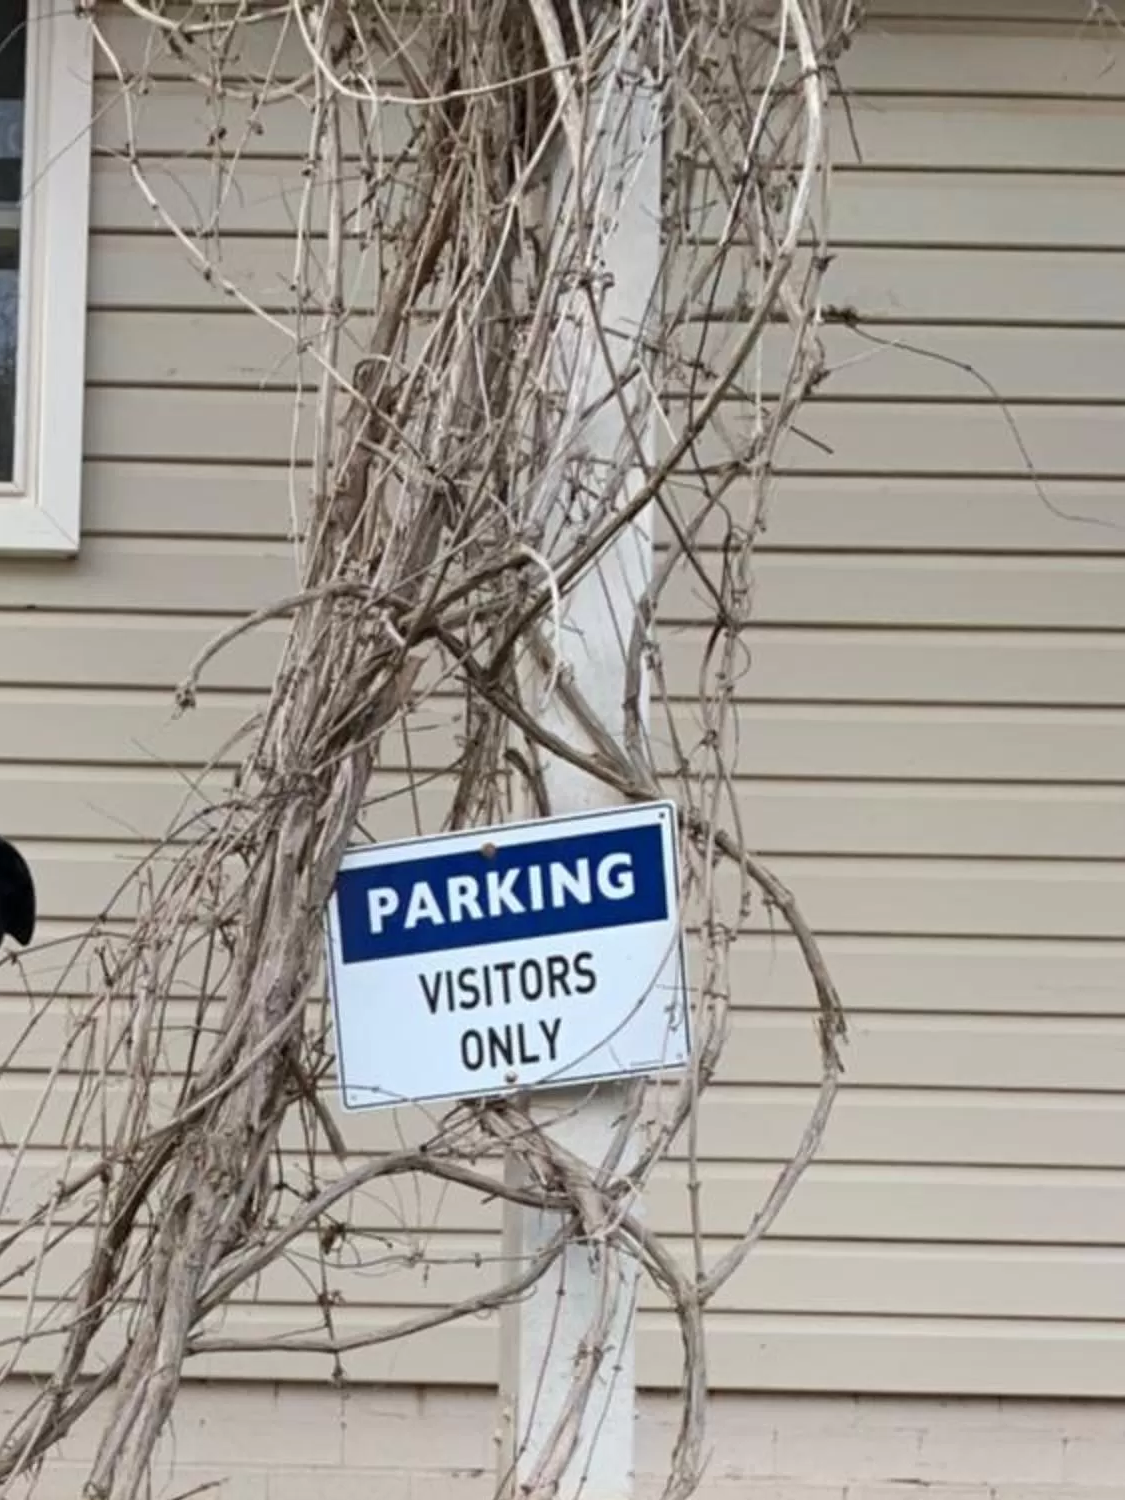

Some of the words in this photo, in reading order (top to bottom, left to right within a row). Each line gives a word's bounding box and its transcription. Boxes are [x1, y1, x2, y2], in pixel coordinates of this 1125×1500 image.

[366, 853, 636, 935] PARKING
[418, 951, 597, 1015] VISITORS
[460, 1017, 563, 1072] ONLY
